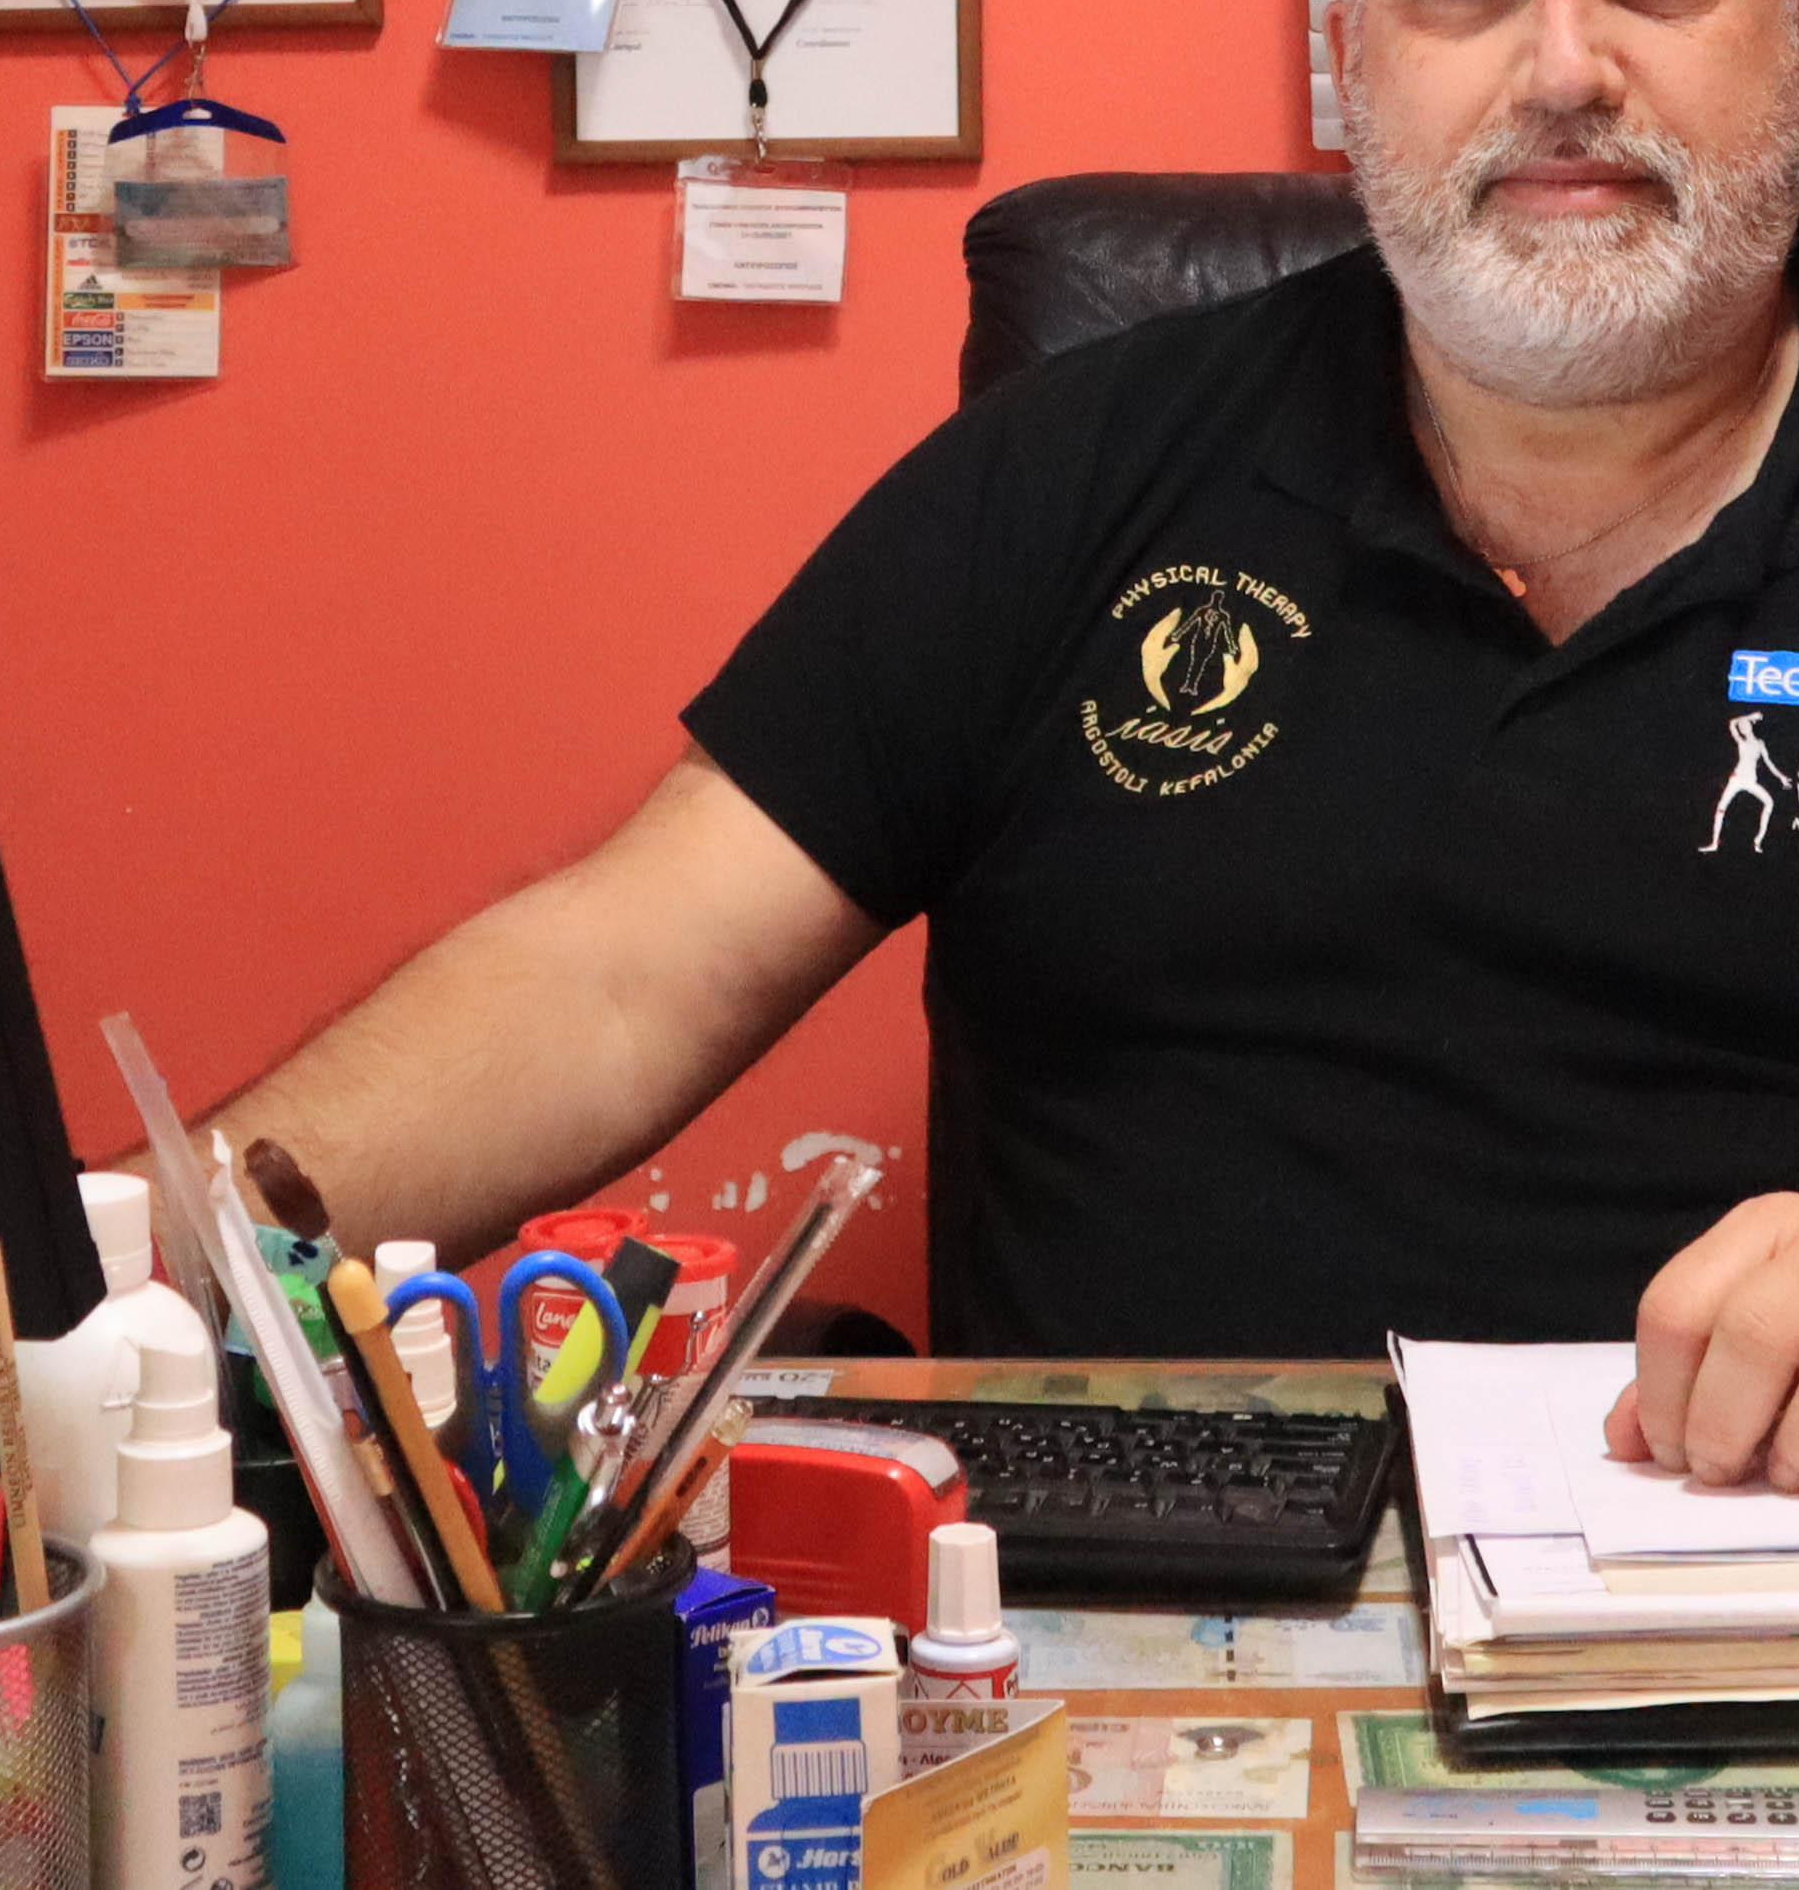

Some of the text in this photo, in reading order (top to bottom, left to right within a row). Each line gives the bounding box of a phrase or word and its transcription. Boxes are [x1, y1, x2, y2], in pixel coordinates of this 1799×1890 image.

[63, 333, 113, 346] EPSON
[1112, 564, 1312, 639] PHYSICAL THERAPY
[1080, 699, 1280, 797] ARGOSTOLI KEFALONIA
[690, 1618, 753, 1650] Pelikan
